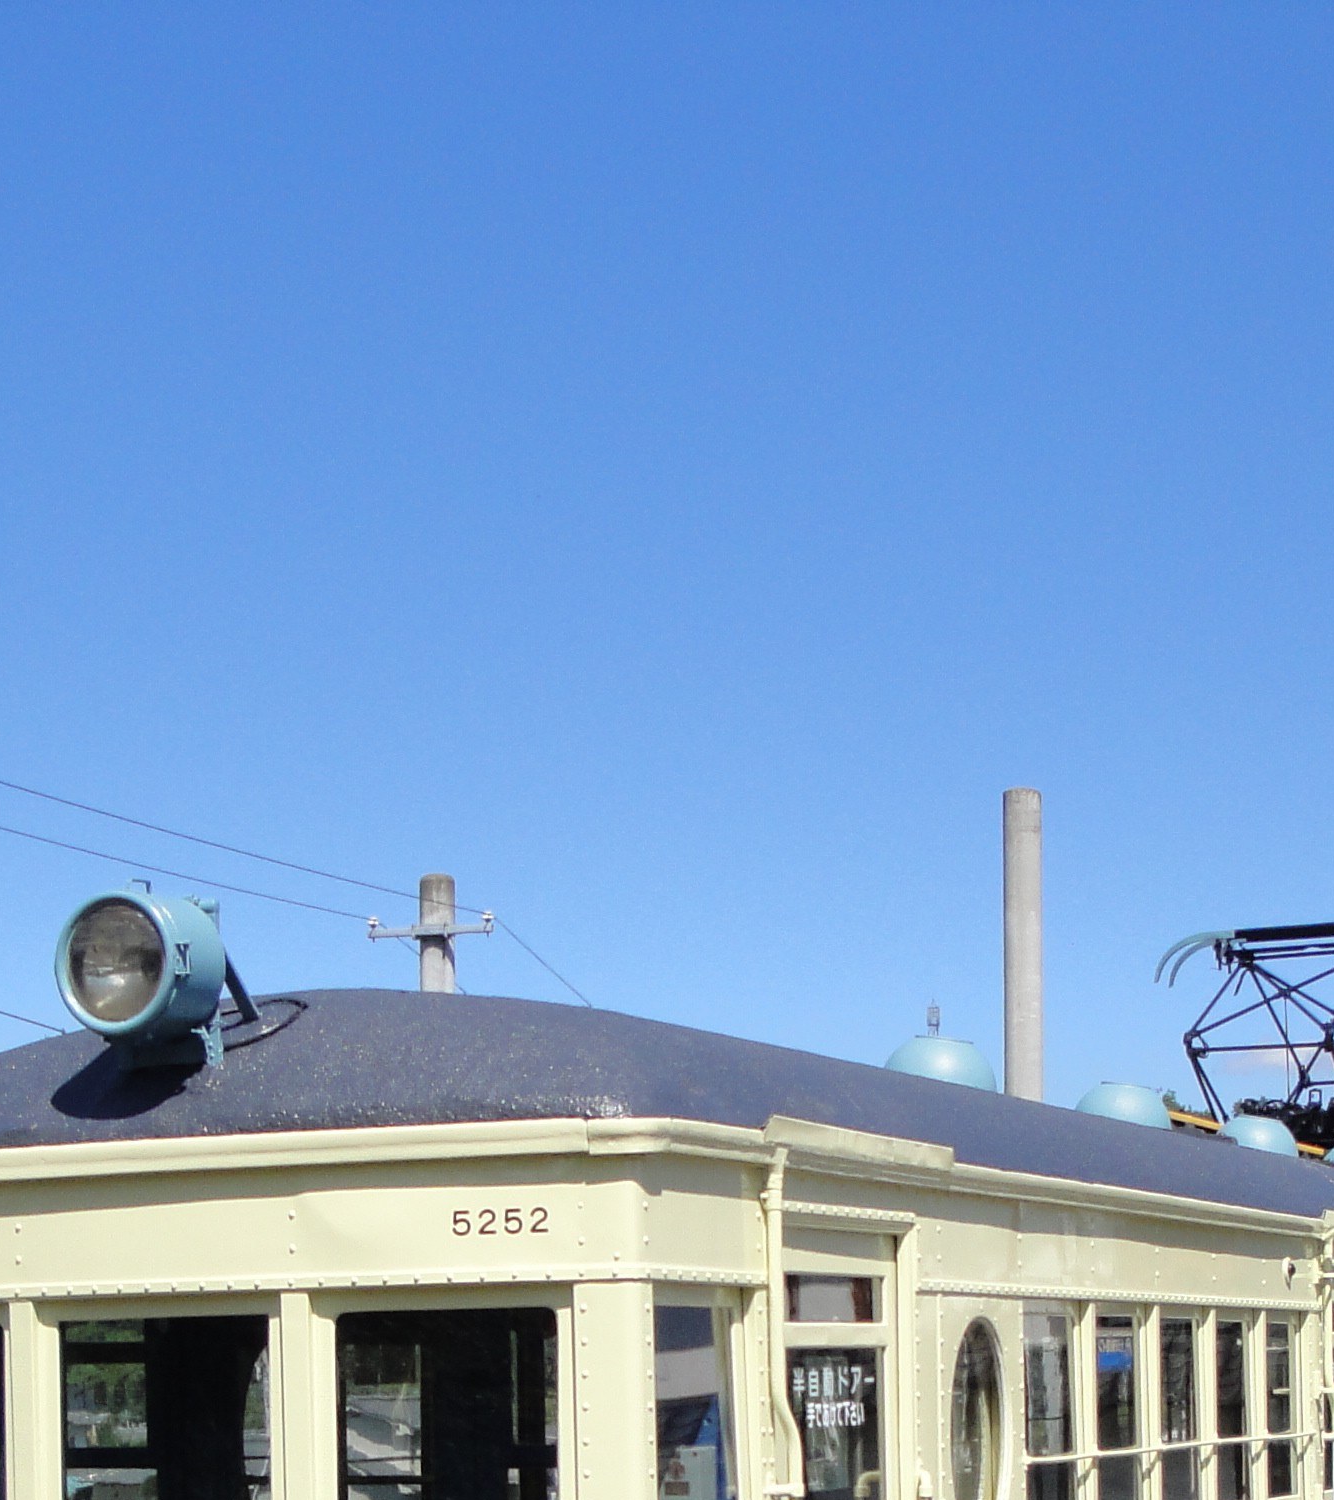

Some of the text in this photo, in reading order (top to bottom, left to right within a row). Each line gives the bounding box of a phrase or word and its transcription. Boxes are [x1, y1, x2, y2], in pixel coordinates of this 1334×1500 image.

[452, 1206, 549, 1237] 5252
[792, 1366, 875, 1398] 半自動ドアー
